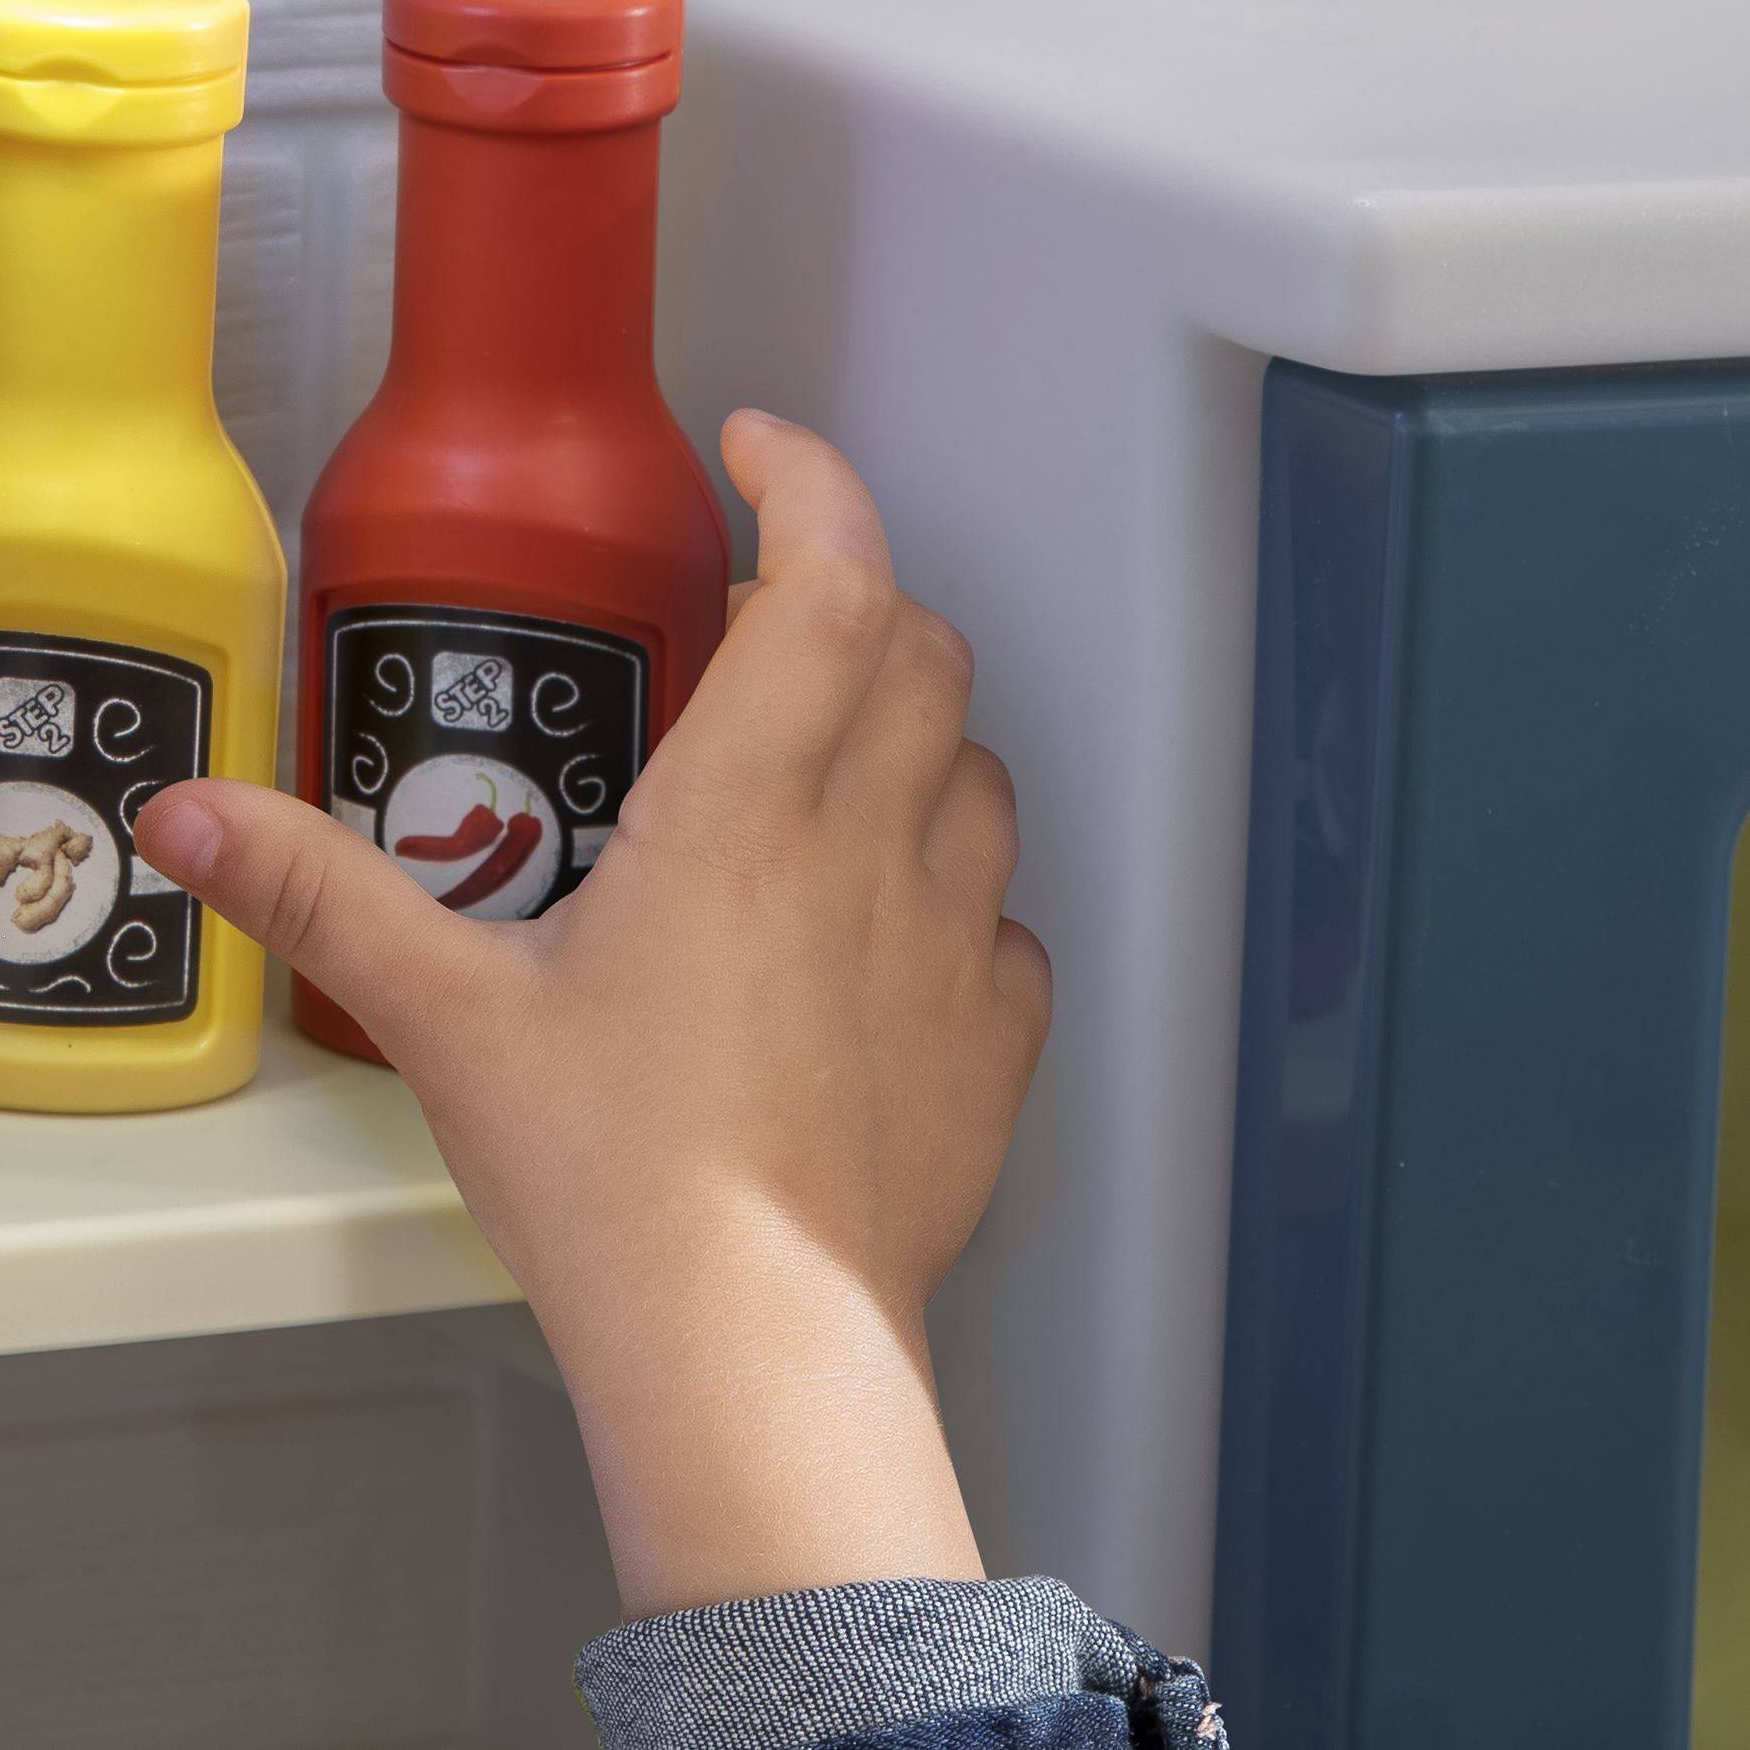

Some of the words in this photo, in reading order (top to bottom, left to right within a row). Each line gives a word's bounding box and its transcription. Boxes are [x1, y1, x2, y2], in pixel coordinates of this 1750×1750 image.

[435, 658, 502, 722] STEP
[476, 695, 509, 728] 2
[37, 721, 71, 754] 2
